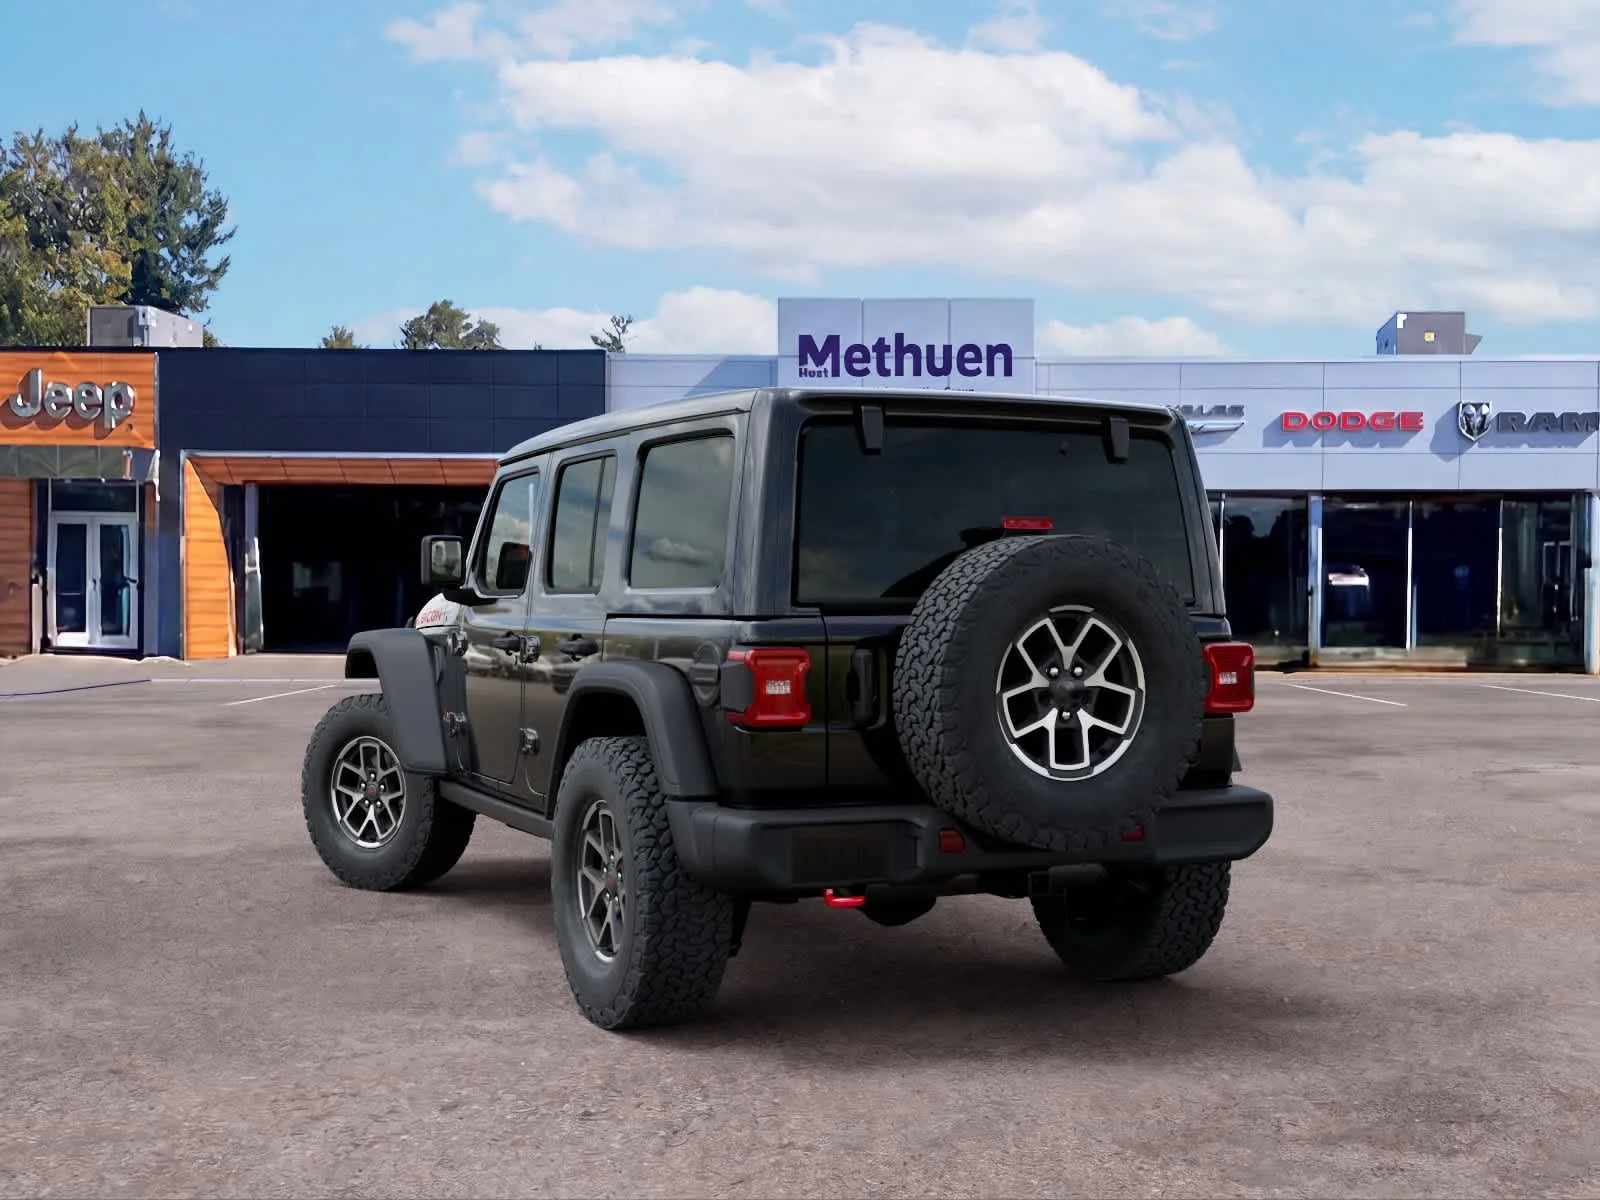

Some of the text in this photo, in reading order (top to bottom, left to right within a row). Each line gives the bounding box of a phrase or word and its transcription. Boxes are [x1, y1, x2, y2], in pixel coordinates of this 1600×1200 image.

[798, 333, 1013, 377] Methuen
[9, 368, 136, 430] Jeep
[1282, 410, 1424, 432] DODGE
[1497, 411, 1599, 433] RAM
